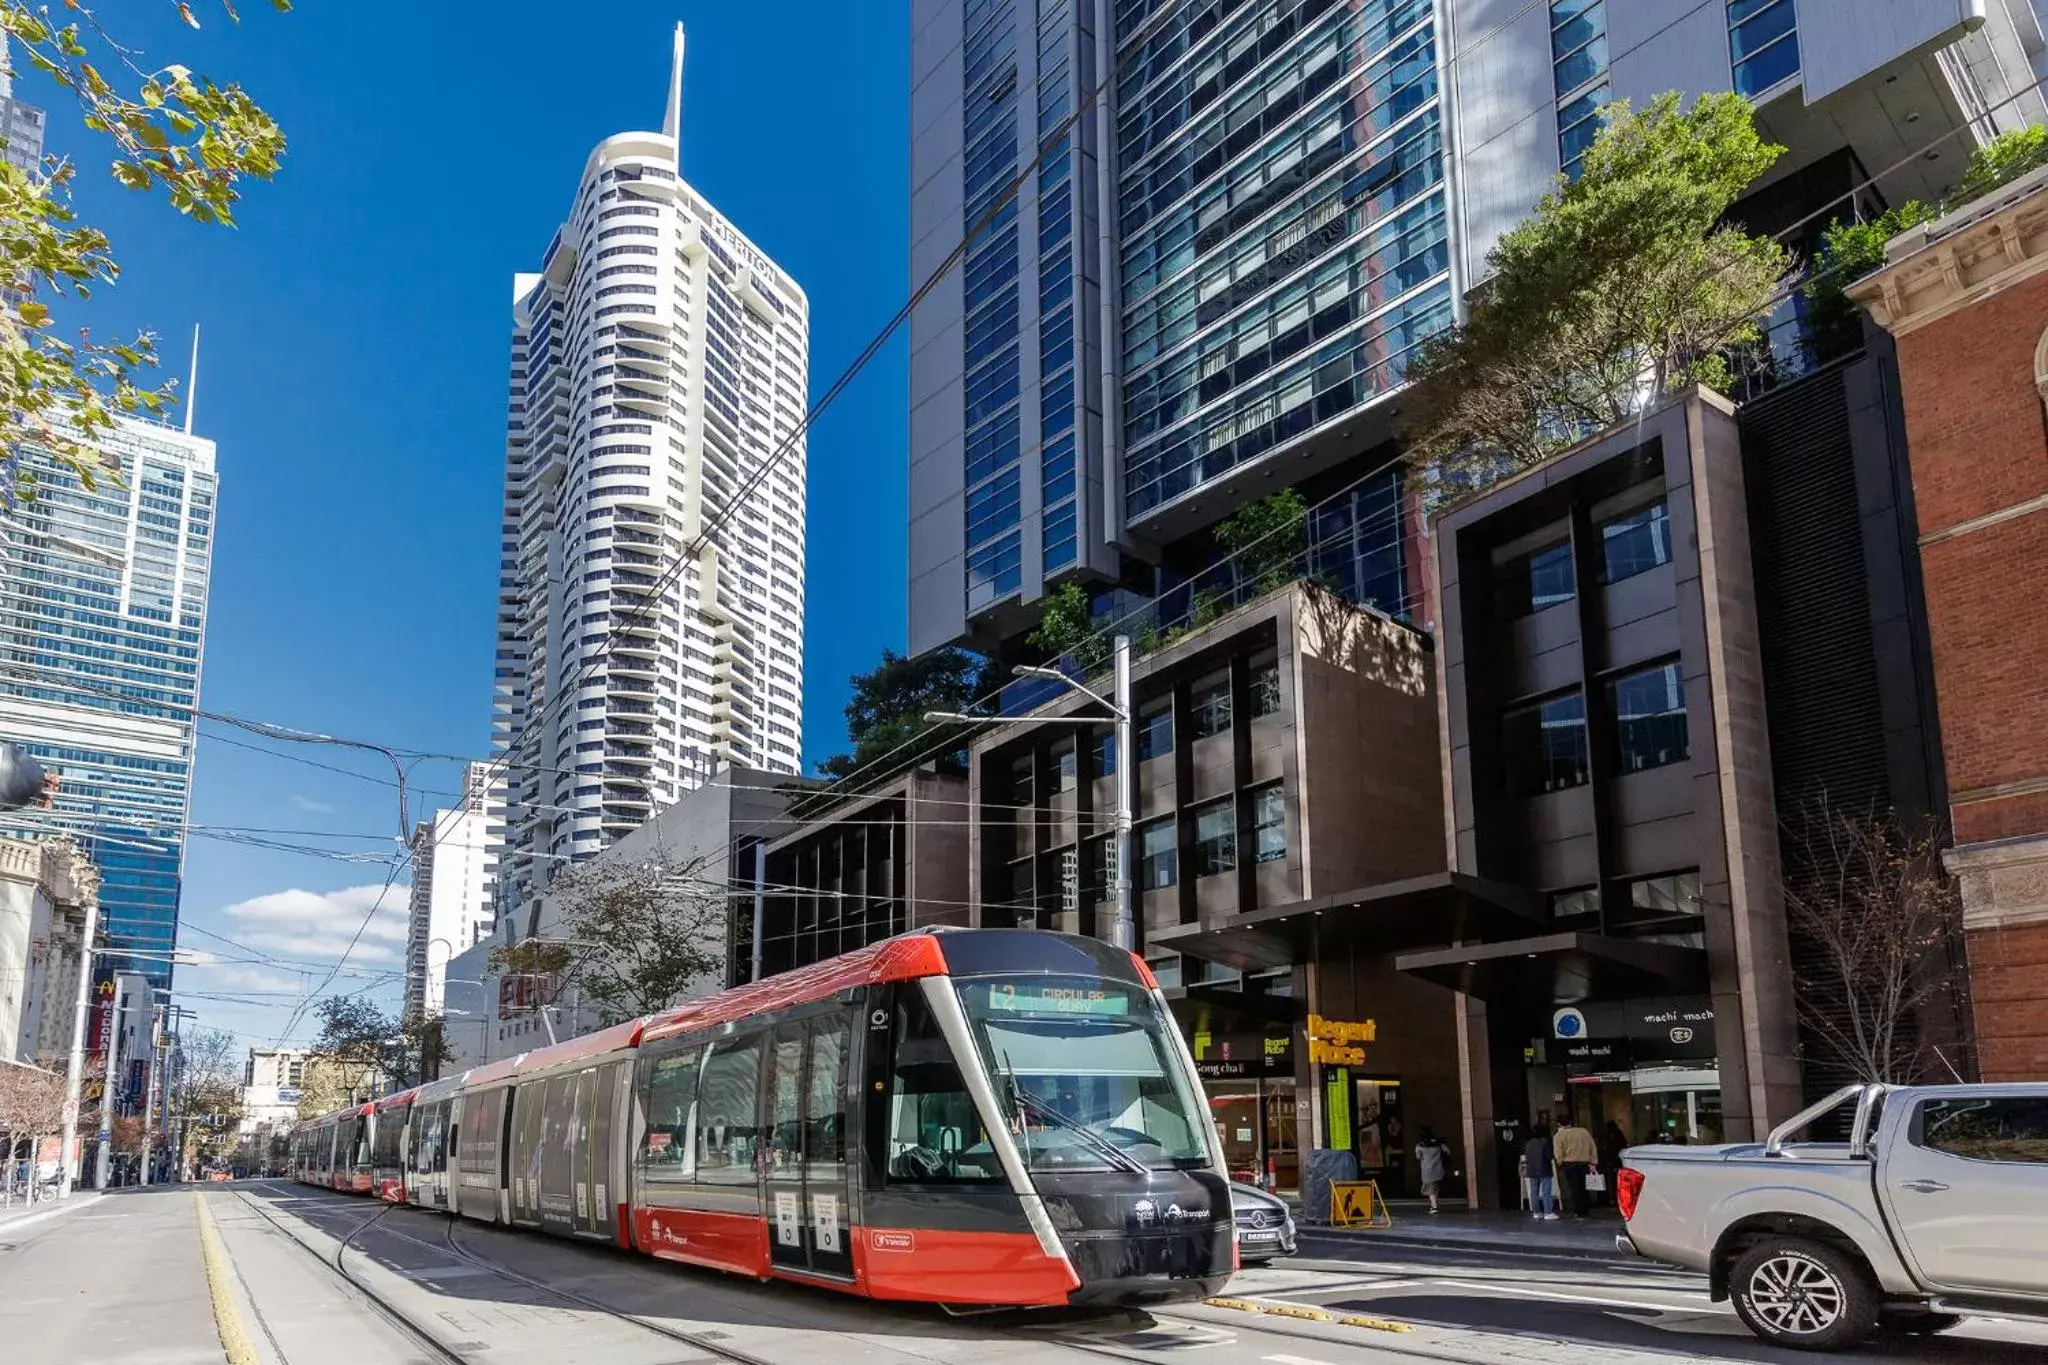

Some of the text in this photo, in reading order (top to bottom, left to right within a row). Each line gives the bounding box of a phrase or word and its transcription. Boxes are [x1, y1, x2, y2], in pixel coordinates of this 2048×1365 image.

[711, 215, 777, 284] MERITON
[989, 984, 1105, 1012] L2 CIRCULAR
[1644, 1010, 1677, 1023] machi
[1308, 1014, 1376, 1046] Regent
[1309, 1040, 1365, 1065] Place
[1182, 1209, 1211, 1218] Transport
